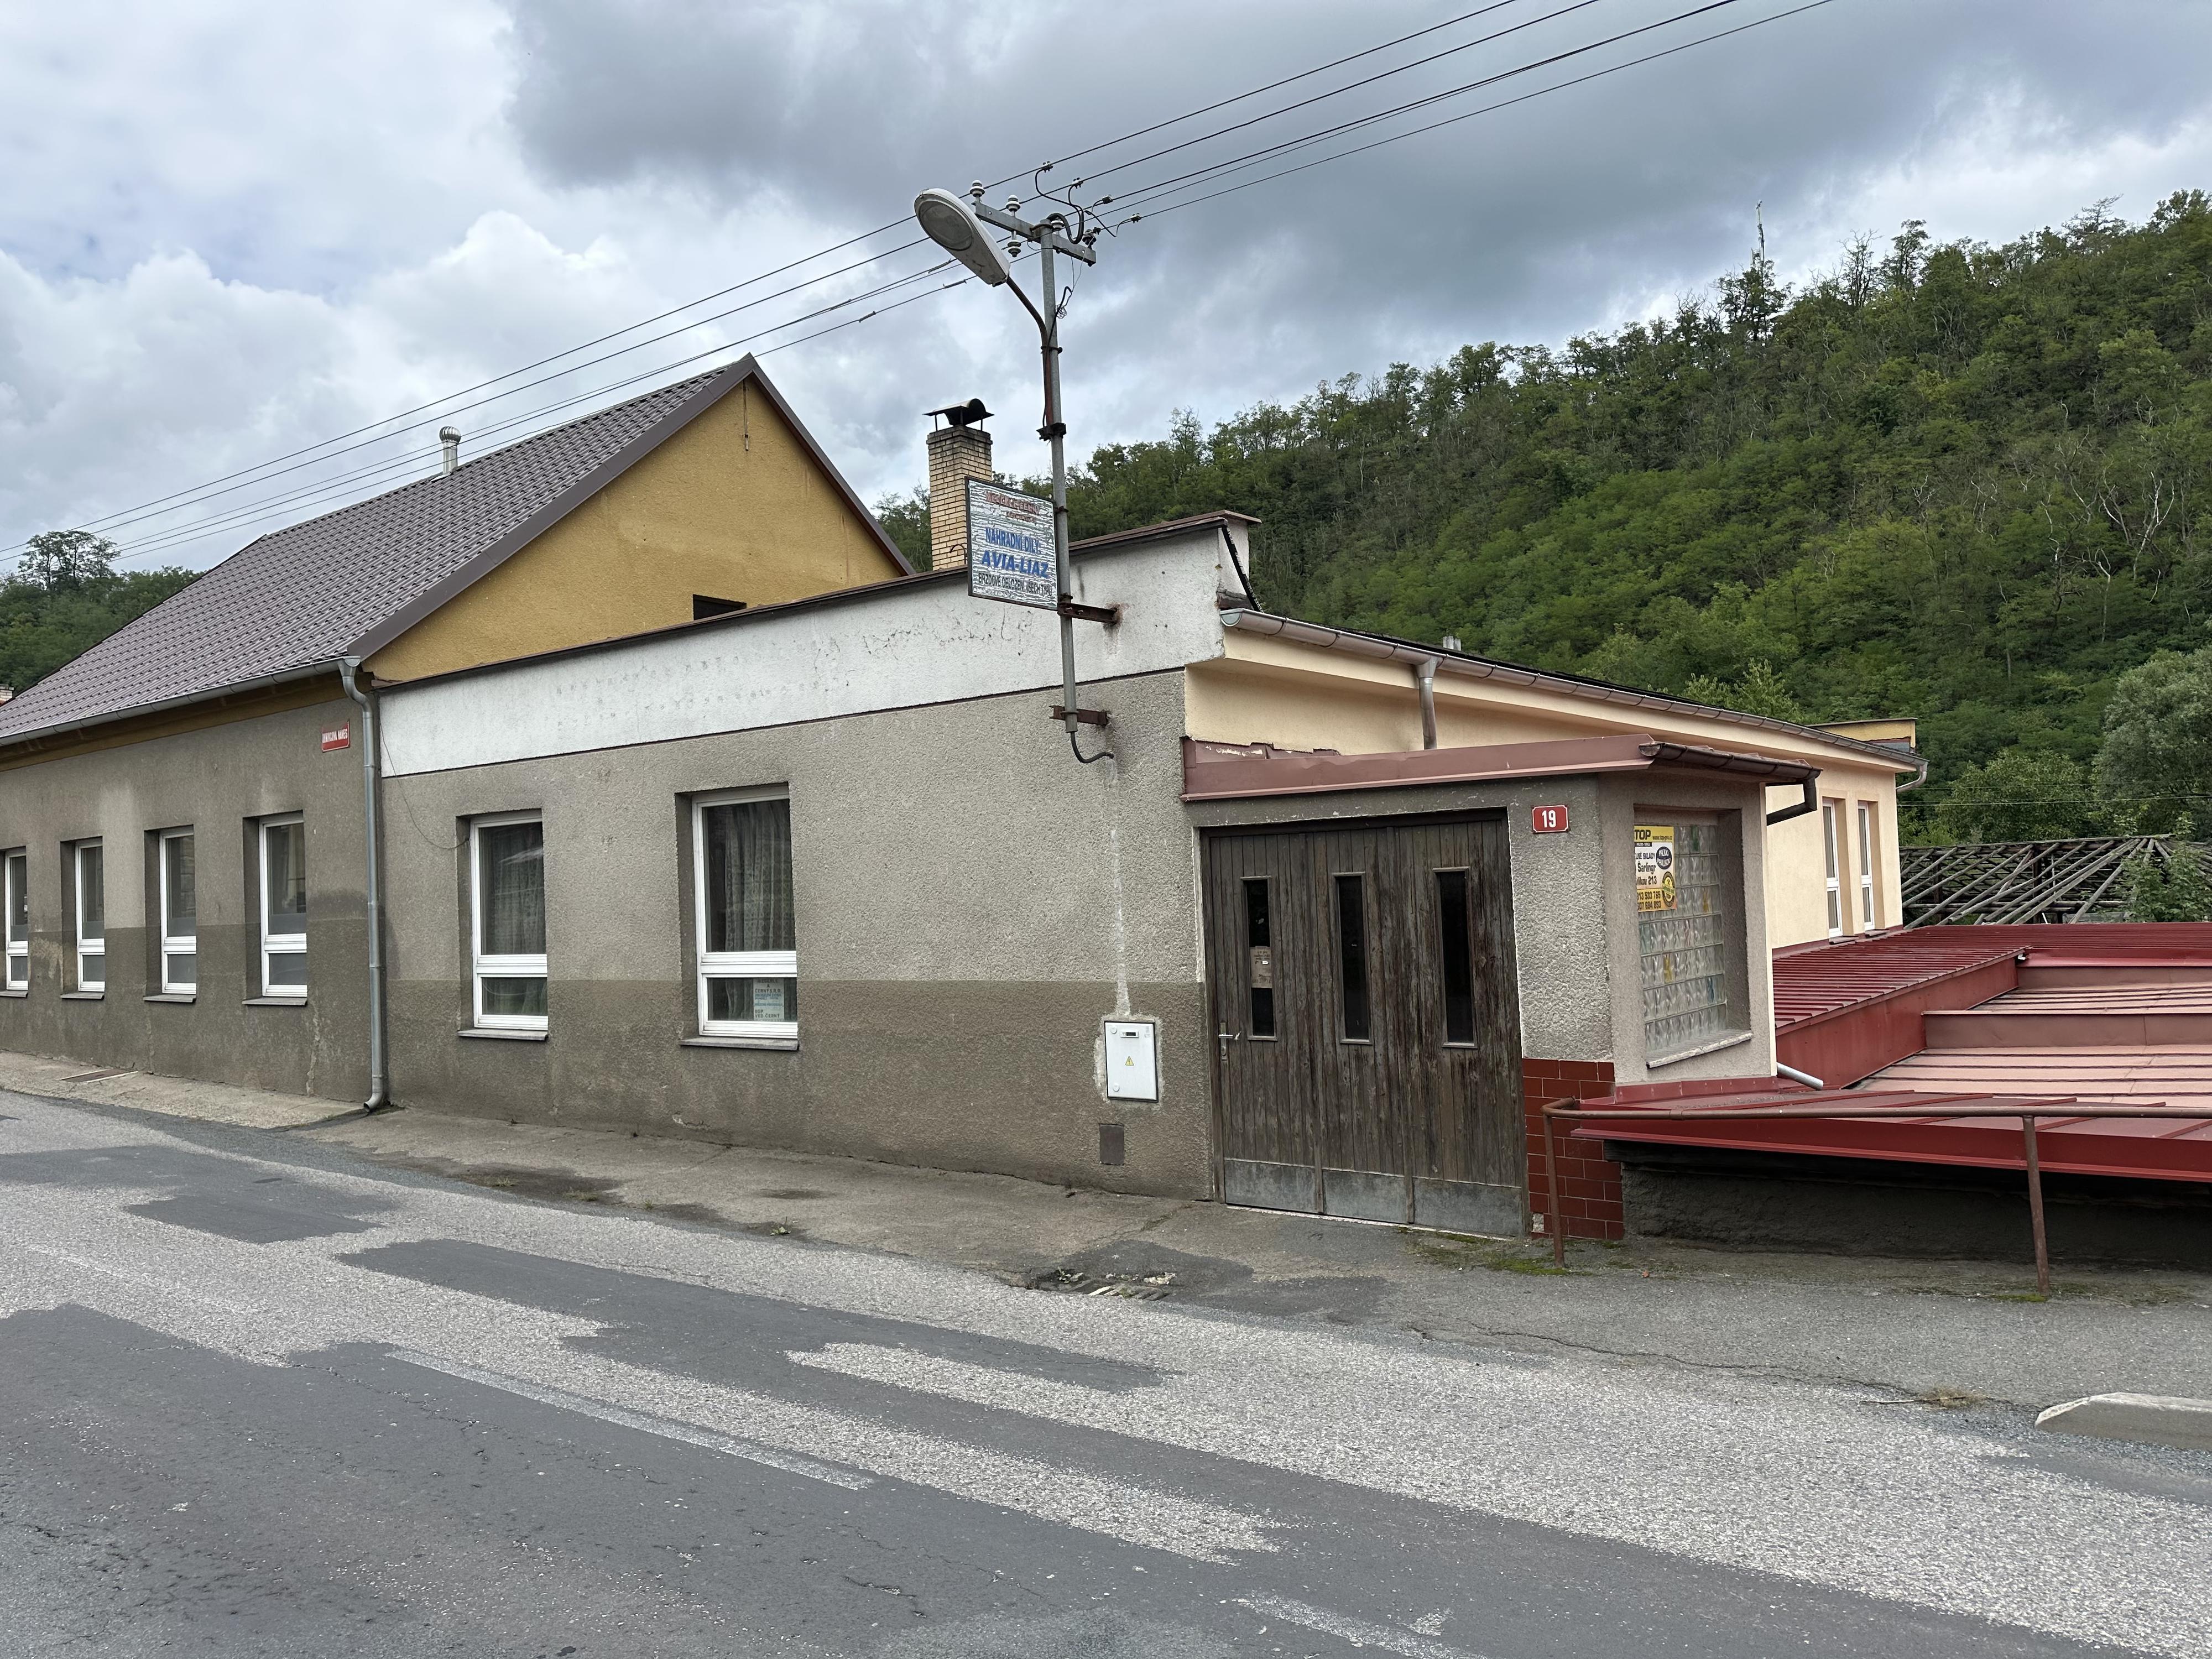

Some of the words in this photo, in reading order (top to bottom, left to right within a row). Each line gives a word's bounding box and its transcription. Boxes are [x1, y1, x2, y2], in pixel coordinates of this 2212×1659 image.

[982, 550, 1049, 578] AVIA-LIAZ
[1542, 810, 1557, 828] 19
[1648, 876, 1657, 885] 213
